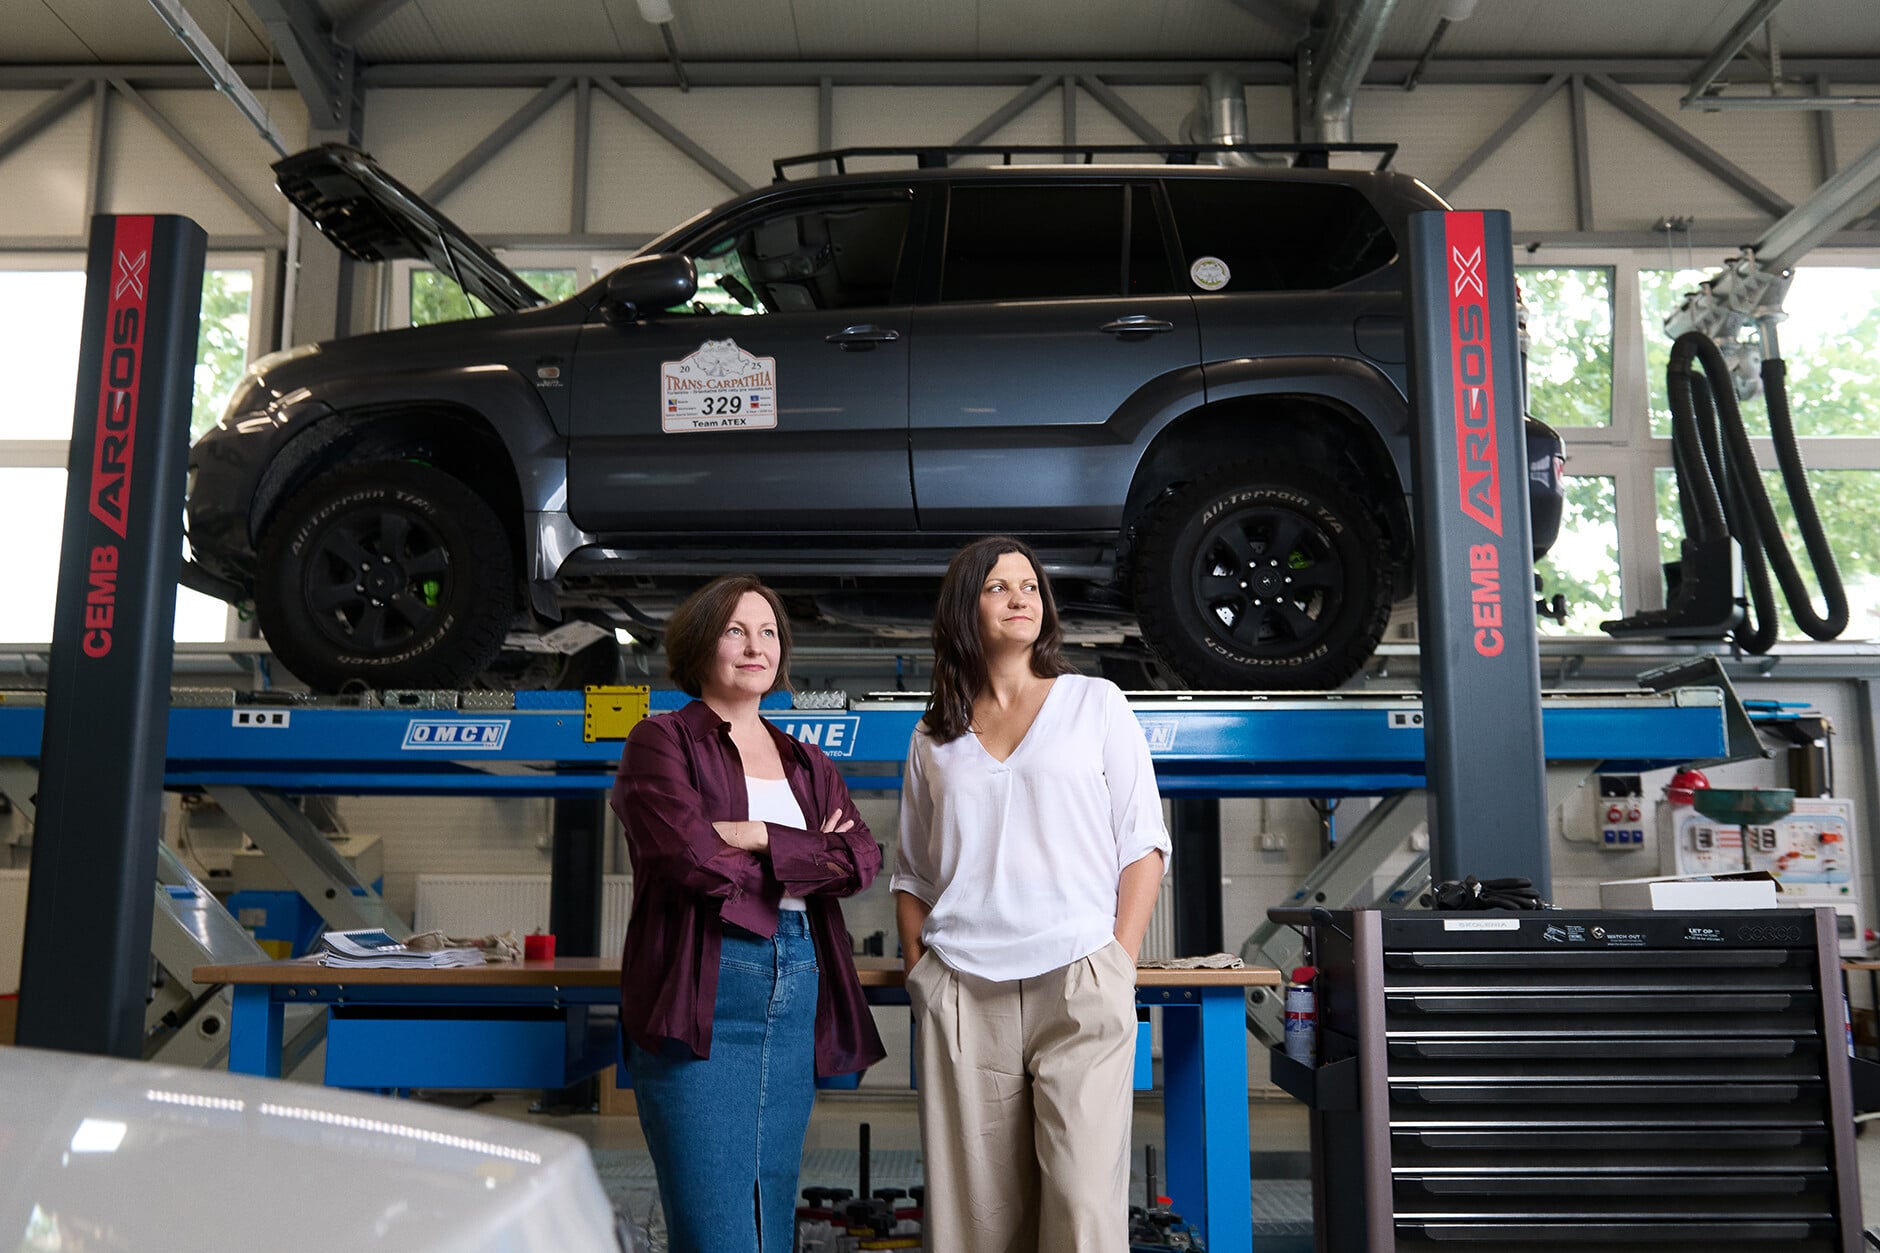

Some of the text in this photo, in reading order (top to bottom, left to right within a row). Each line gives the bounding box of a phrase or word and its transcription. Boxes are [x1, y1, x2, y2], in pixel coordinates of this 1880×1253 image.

[680, 362, 762, 373] 20 25
[666, 371, 772, 391] TRANS-CARPATHIA
[701, 395, 742, 415] 329
[693, 418, 746, 428] Team ATEX
[83, 250, 146, 658] CEMB ARGOS X
[1453, 246, 1505, 657] CEMB ARGOS X
[292, 490, 385, 556] All-Terrain
[1203, 489, 1344, 534] All-Terrain T/A
[1204, 636, 1329, 666] BFGoodrich
[413, 726, 500, 742] OMCN
